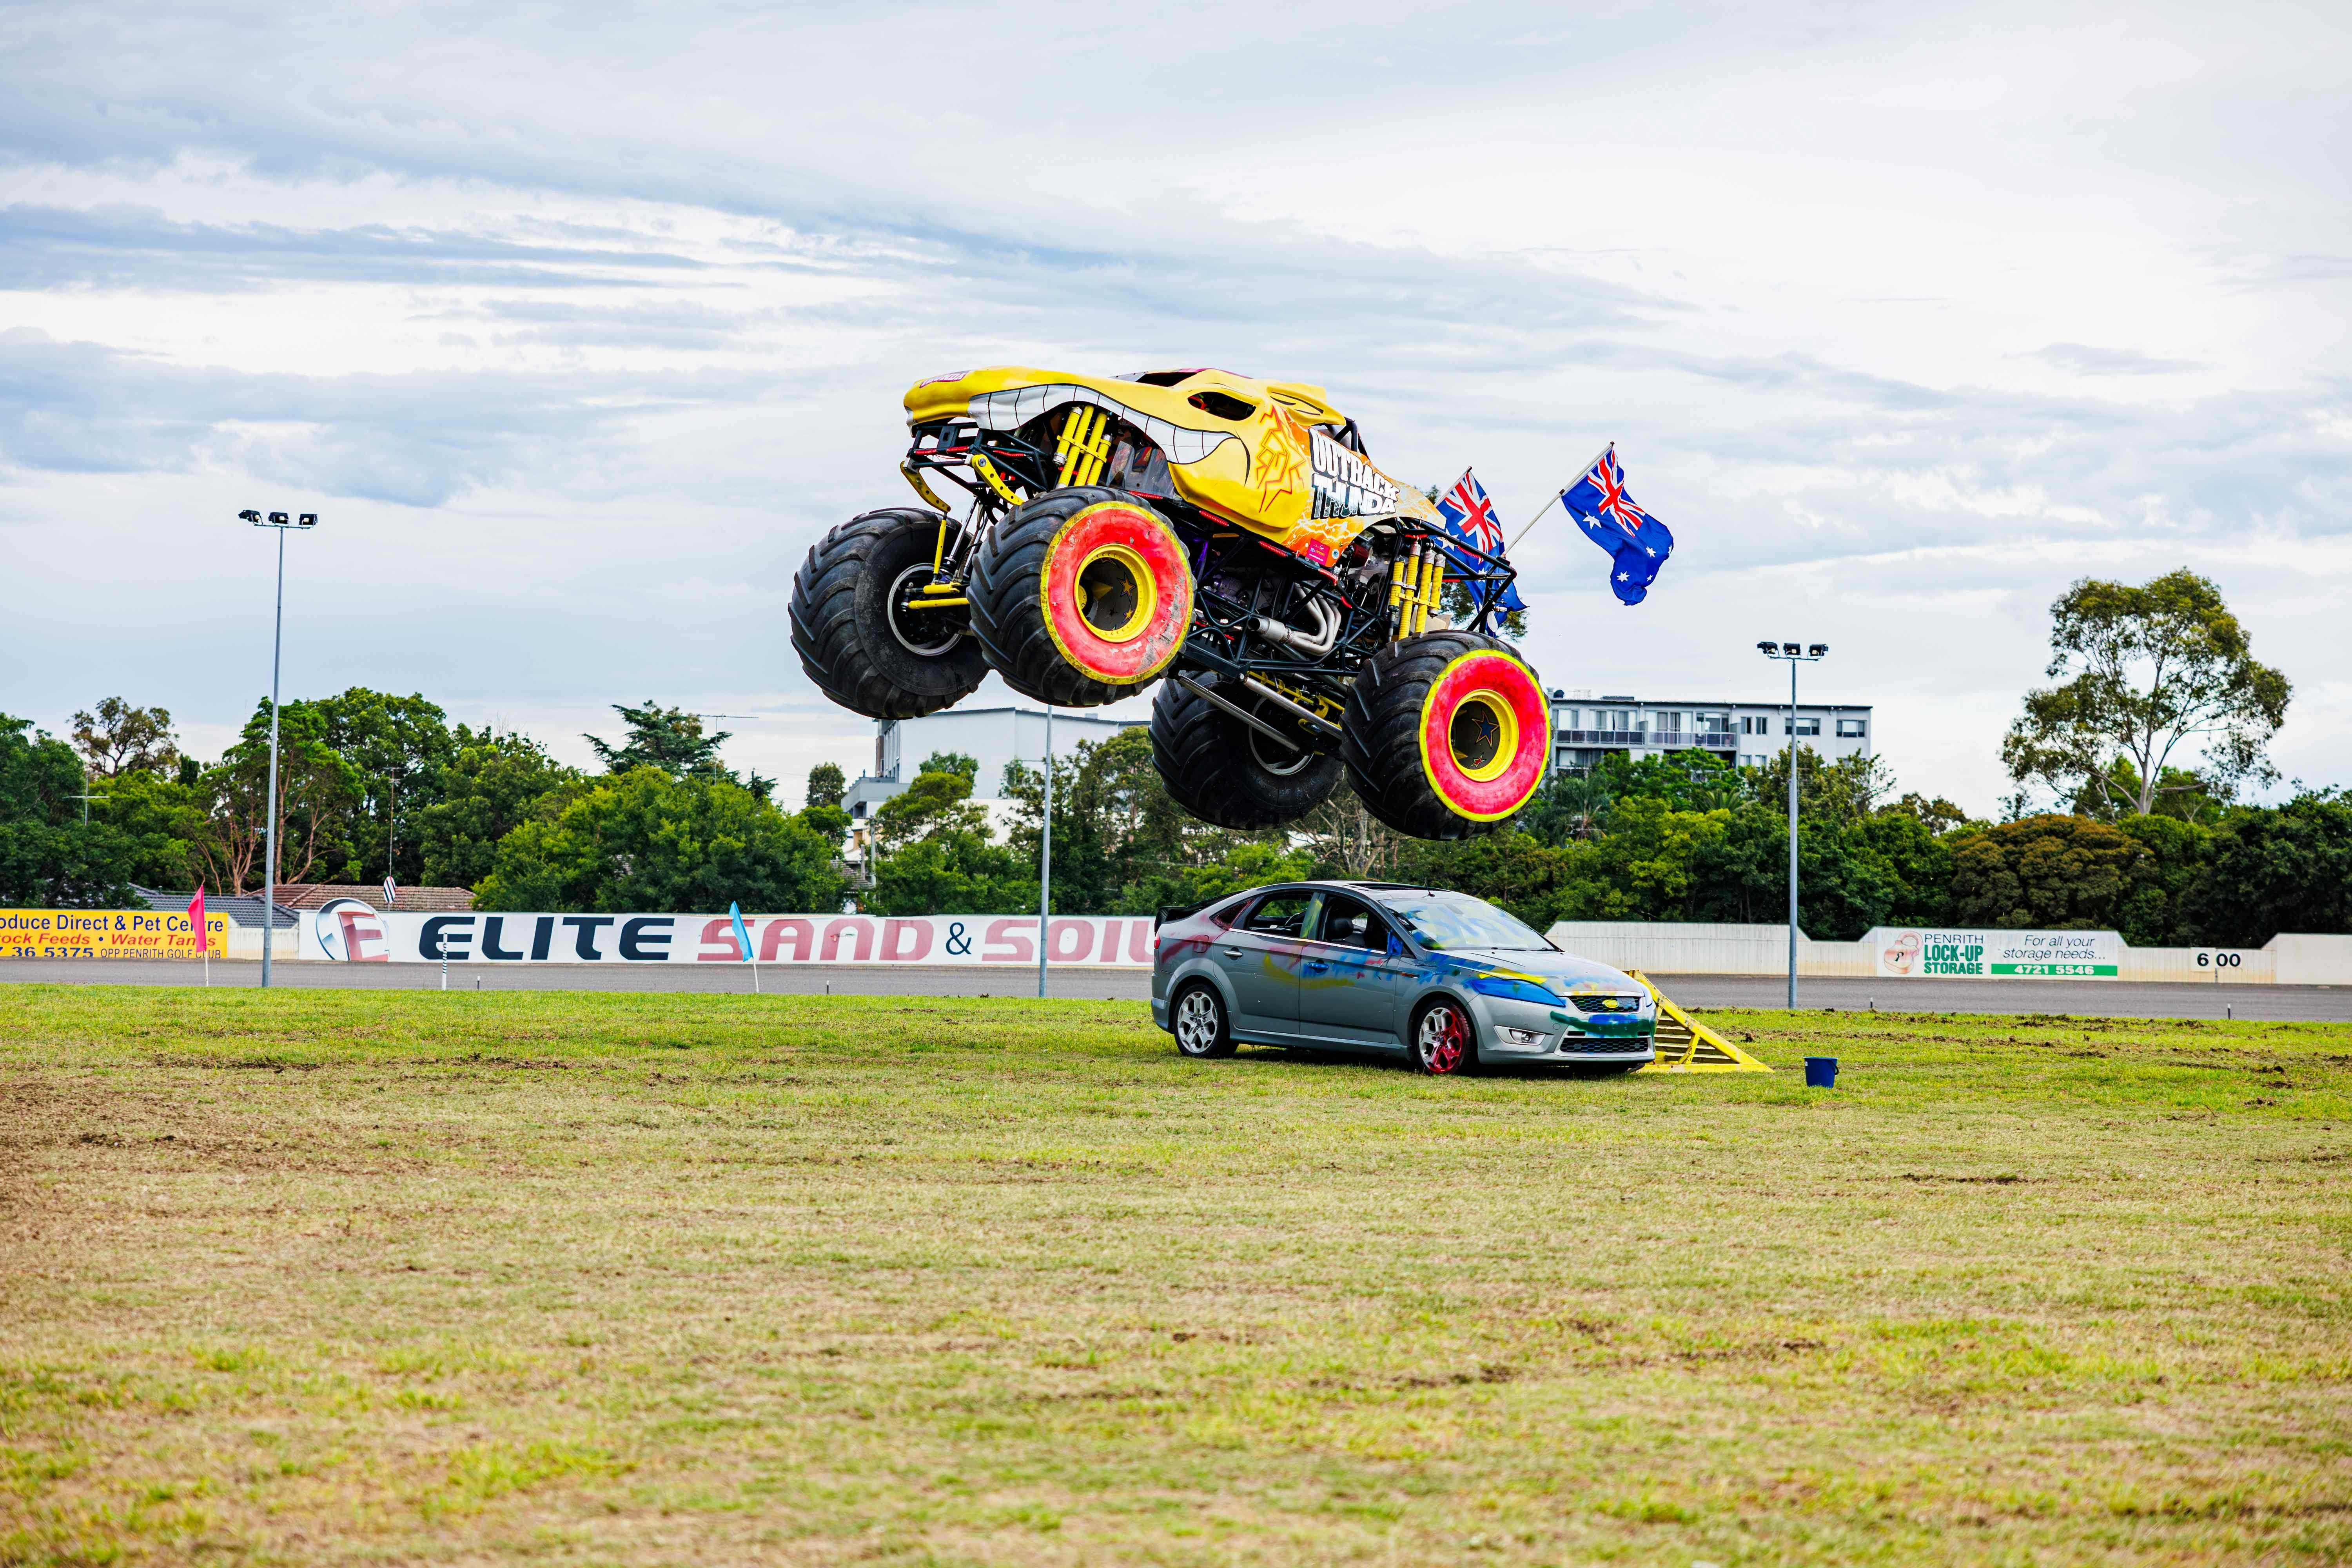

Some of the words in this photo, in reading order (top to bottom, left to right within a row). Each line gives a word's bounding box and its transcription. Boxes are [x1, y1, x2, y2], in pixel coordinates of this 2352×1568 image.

[1308, 428, 1400, 501] OUTBACK
[1312, 473, 1396, 519] THUNDA
[57, 915, 108, 930] Direct
[114, 915, 126, 931] &
[133, 916, 160, 931] Pet
[167, 916, 223, 932] Cere
[0, 933, 33, 944] ock
[38, 933, 90, 944] Feeds
[112, 934, 161, 946] Water
[167, 935, 216, 946] Tans
[419, 916, 675, 960] ELITE
[697, 918, 933, 961] SAND
[945, 922, 971, 955] &
[1925, 934, 1984, 944] PENRITH
[2024, 935, 2045, 946] For
[2049, 936, 2063, 946] all
[2065, 938, 2095, 949] your
[12, 947, 36, 957] 36
[44, 947, 94, 958] 5375
[101, 948, 120, 958] OPP
[123, 949, 163, 958] PENRITH
[167, 949, 193, 958] GOLF
[1924, 944, 1984, 961] LOCK-UP
[2003, 948, 2052, 961] storage
[2055, 949, 2105, 960] needs...
[1924, 962, 1983, 975] STORAGE
[2014, 965, 2049, 974] 4721
[2055, 965, 2094, 975] 5546
